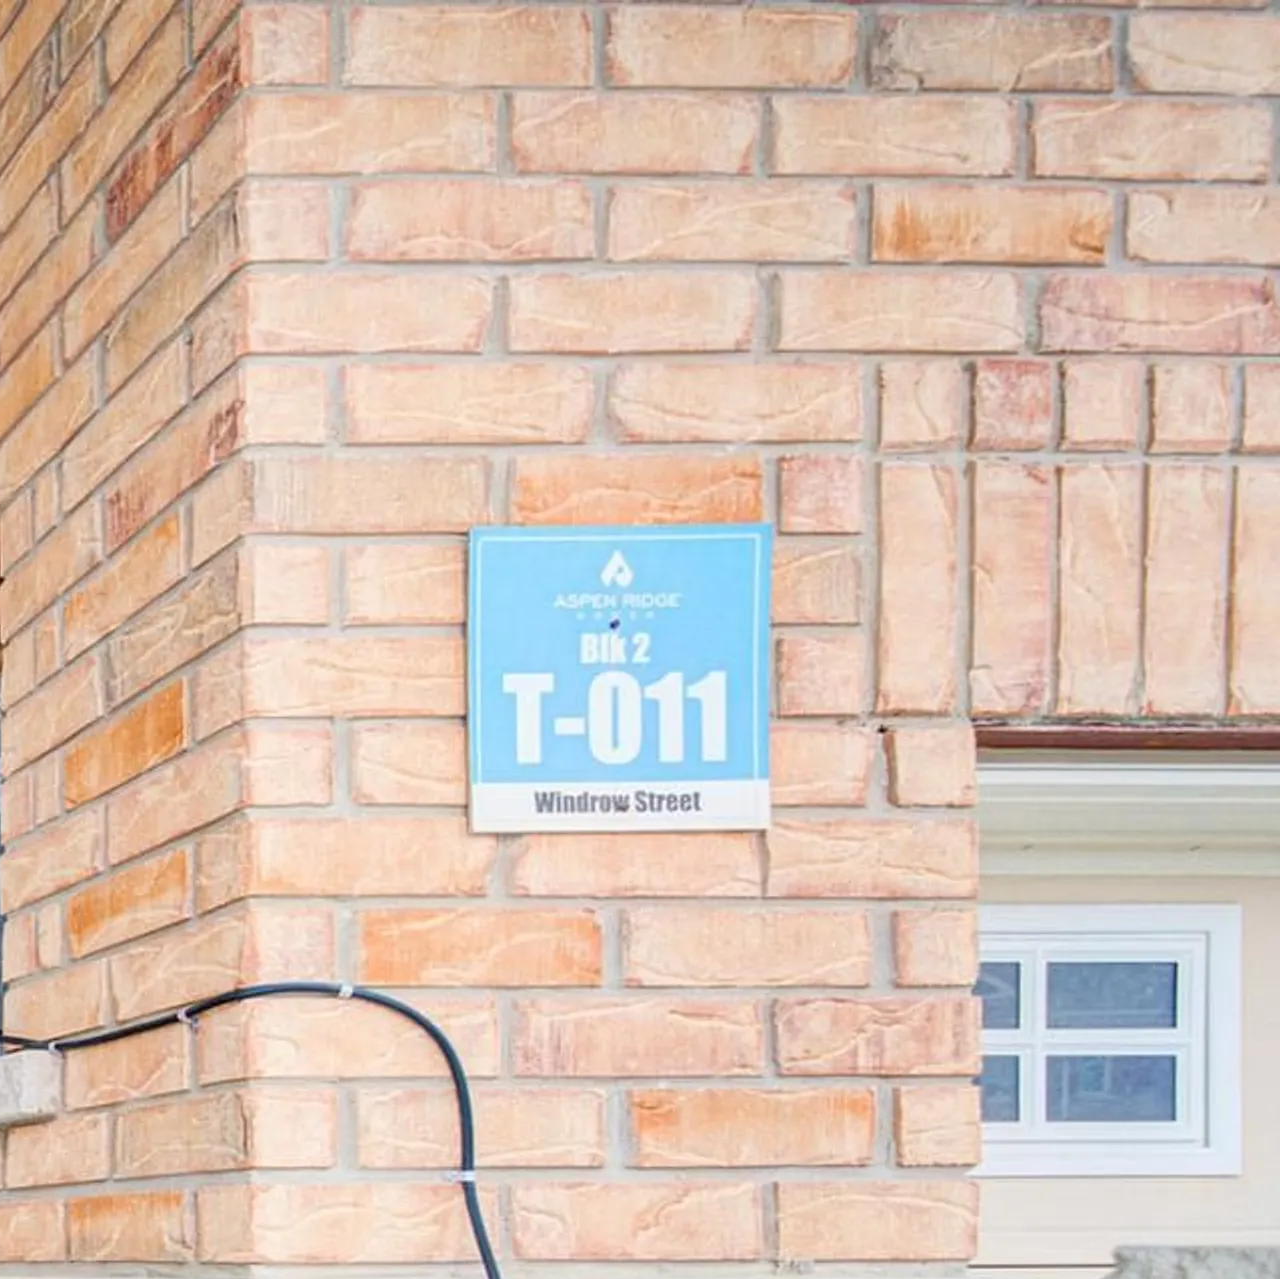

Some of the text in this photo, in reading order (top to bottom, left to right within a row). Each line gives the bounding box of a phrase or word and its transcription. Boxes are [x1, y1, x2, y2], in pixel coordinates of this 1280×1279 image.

[553, 592, 682, 609] ASPEN RIDGE
[580, 632, 651, 664] Blk 2
[502, 671, 727, 765] T-011
[534, 790, 701, 813] Windrow Street
